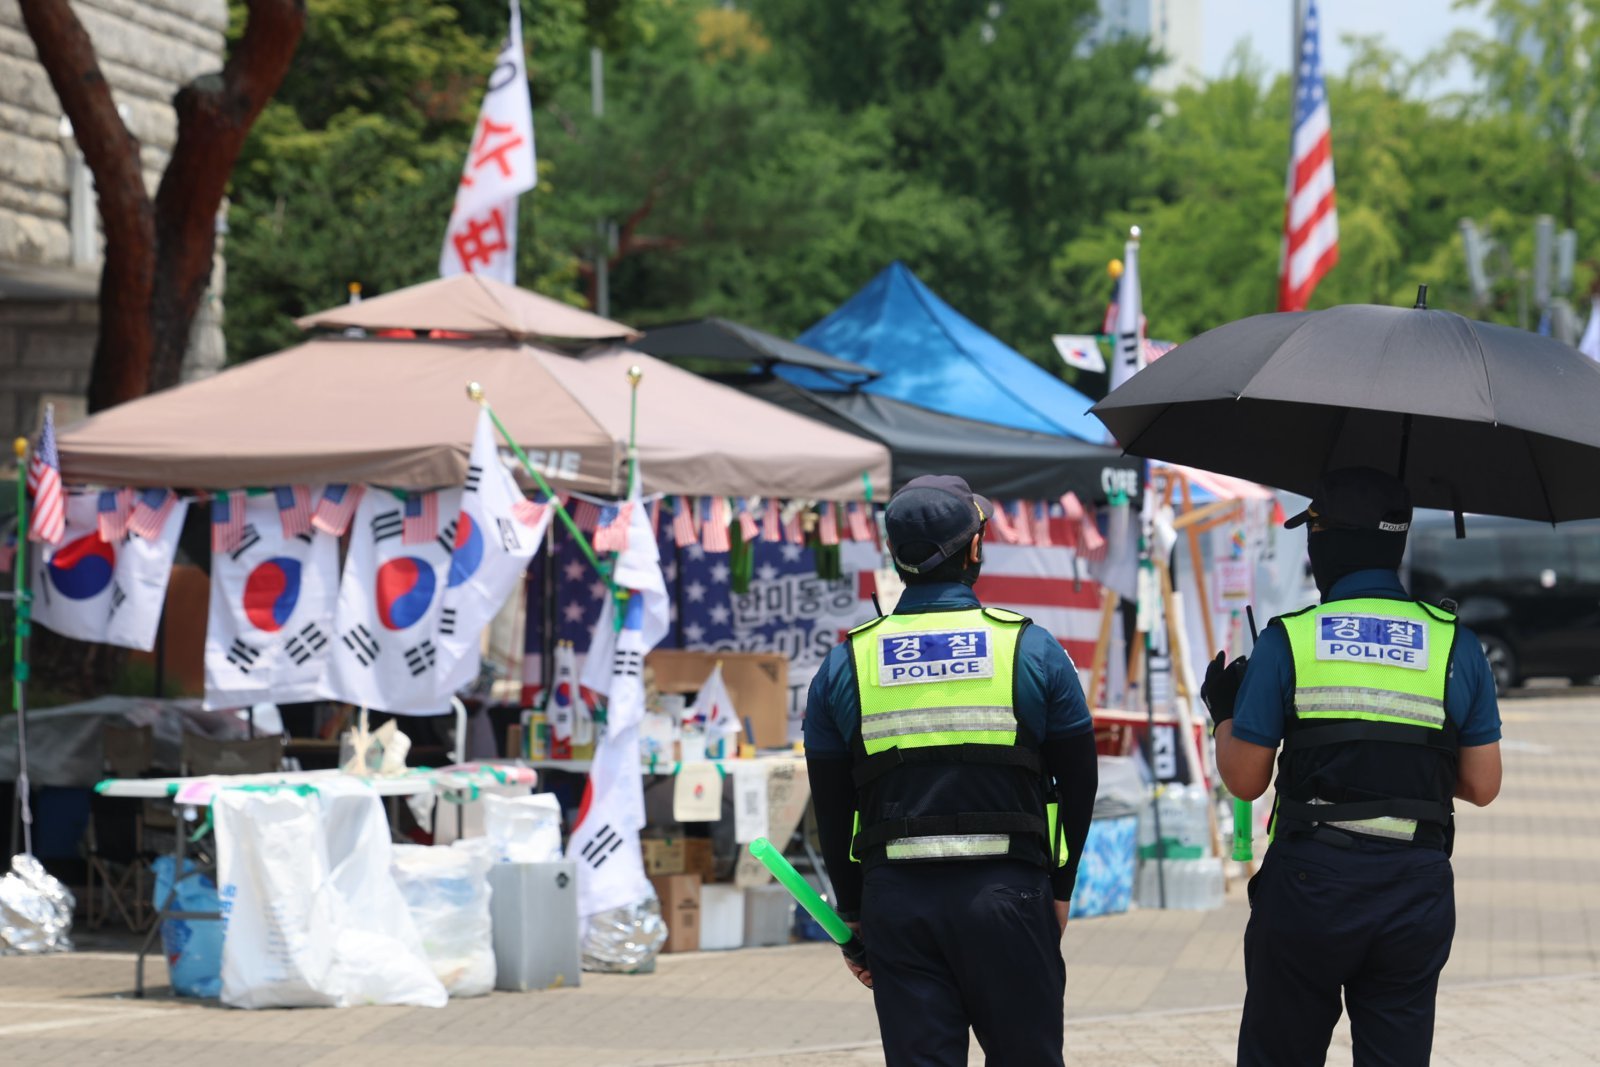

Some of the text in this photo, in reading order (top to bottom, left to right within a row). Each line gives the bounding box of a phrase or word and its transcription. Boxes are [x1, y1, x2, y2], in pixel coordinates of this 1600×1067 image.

[1331, 618, 1416, 647] 경찰
[892, 633, 979, 661] 경찰
[1329, 643, 1416, 664] POLICE
[892, 660, 980, 680] POLICE
